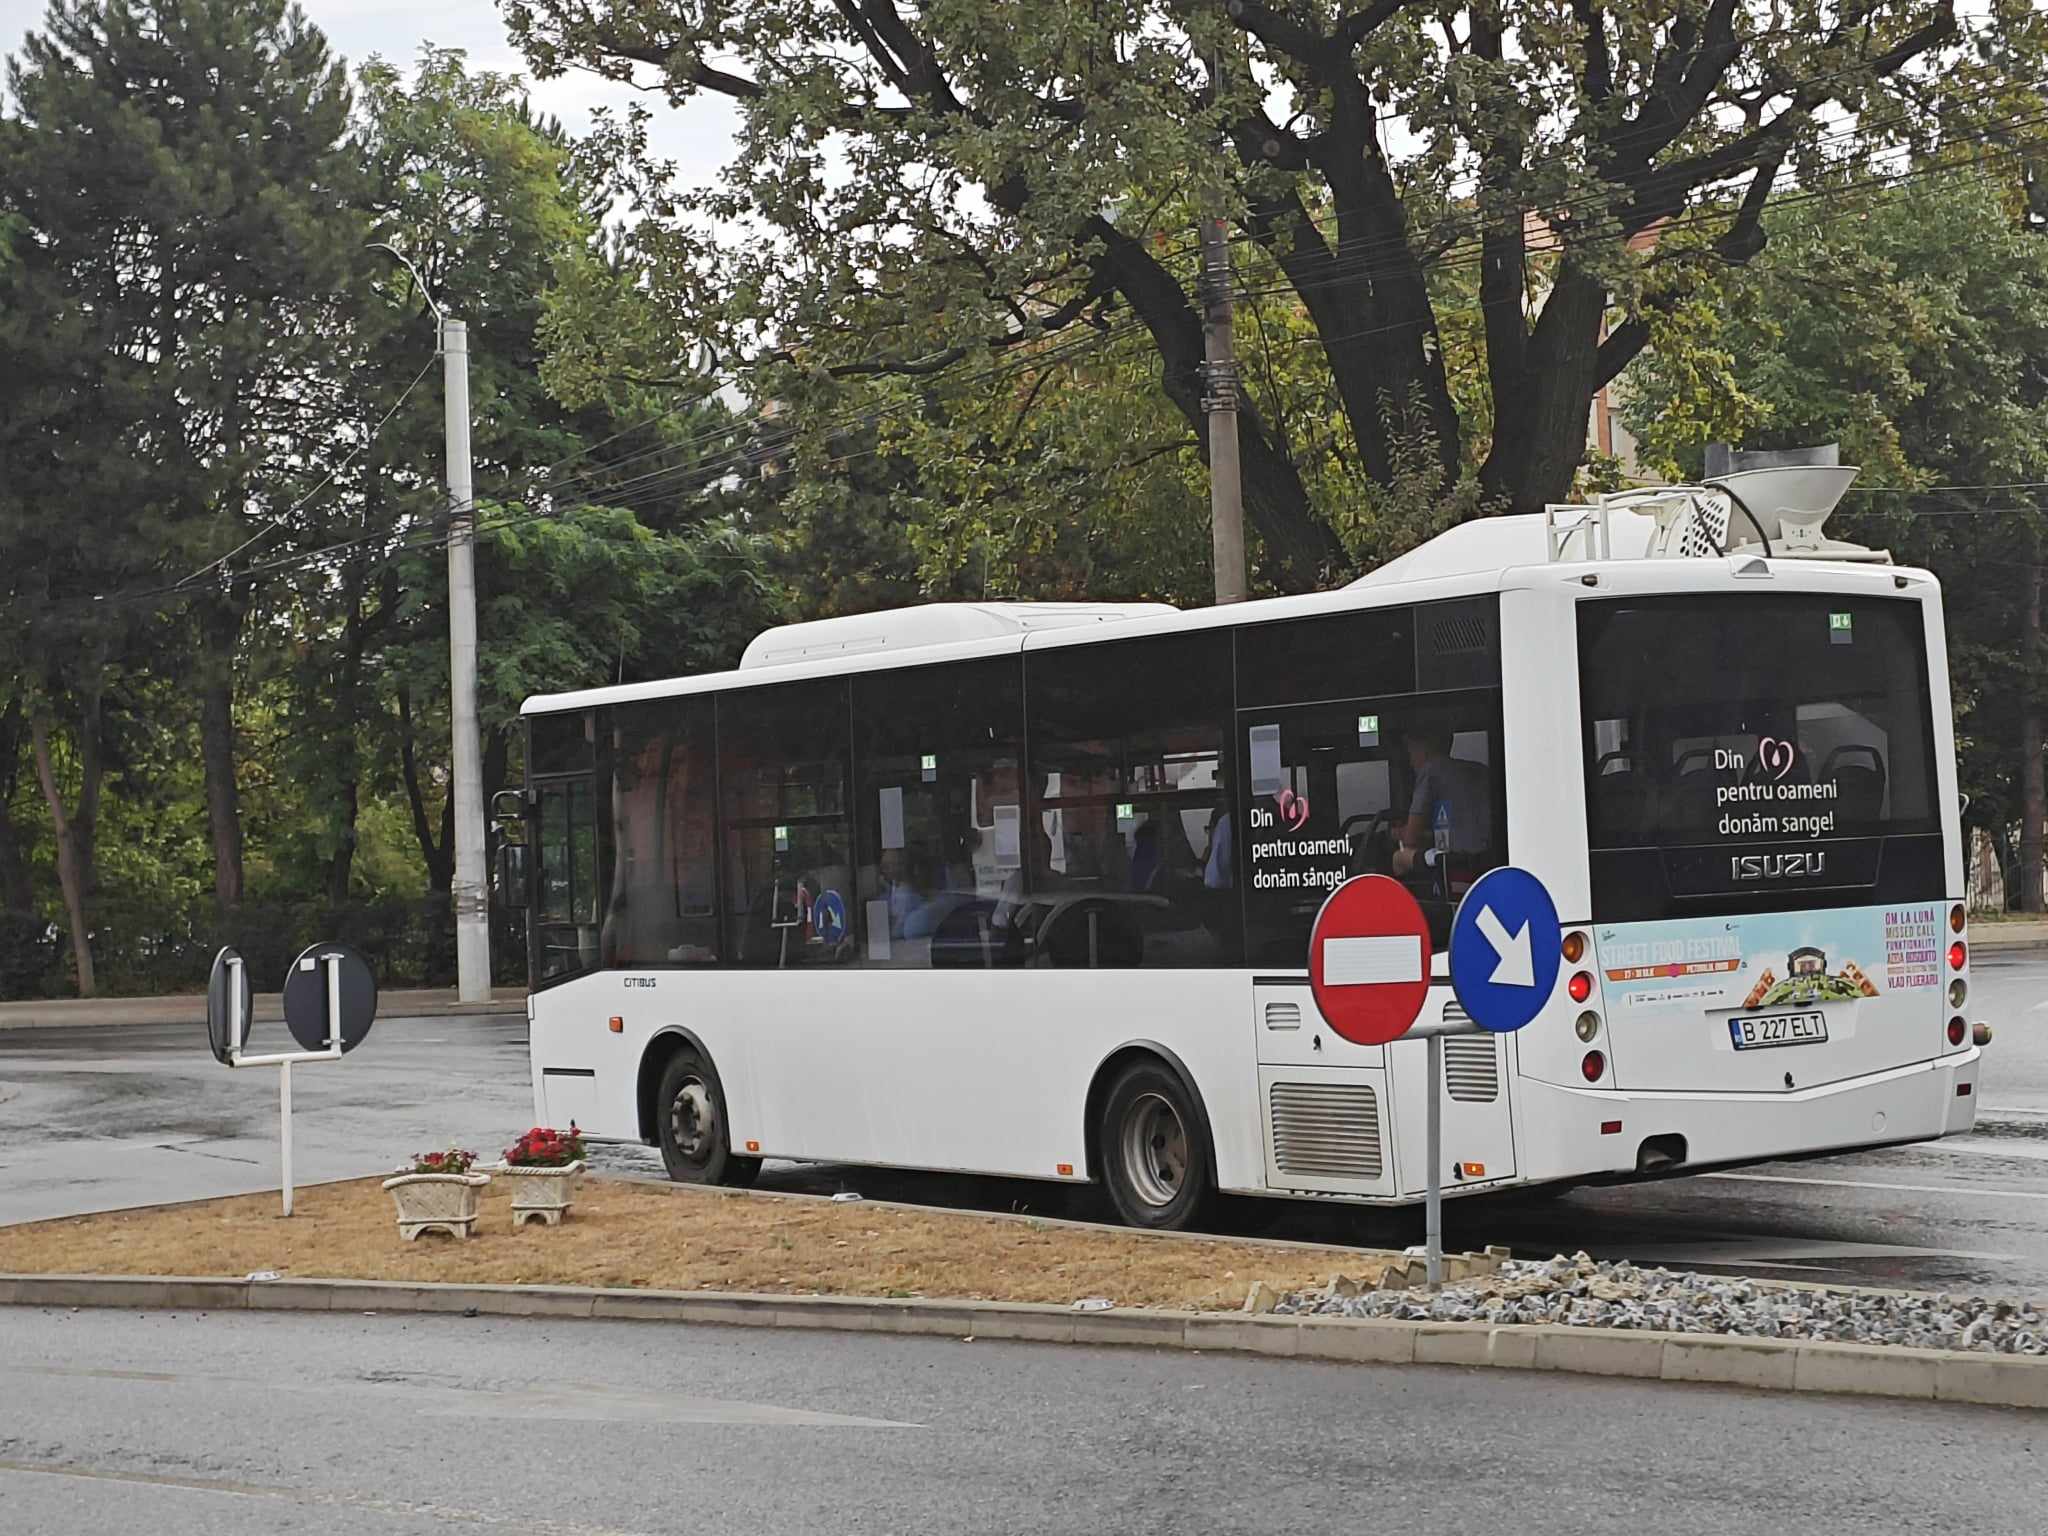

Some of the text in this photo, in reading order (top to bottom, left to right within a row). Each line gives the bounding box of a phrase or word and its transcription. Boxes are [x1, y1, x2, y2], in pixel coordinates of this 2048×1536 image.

[1715, 748, 1744, 769] Din
[1716, 778, 1837, 807] pentru oameni
[1251, 808, 1273, 828] Din
[1718, 810, 1834, 838] donăm sange!
[1252, 833, 1353, 863] pentru oameni,
[1253, 867, 1300, 888] donăm
[1731, 851, 1825, 880] ISUZU
[1651, 938, 1685, 963] FOOD
[1687, 935, 1742, 959] FESTIVAL
[1743, 1015, 1819, 1041] B 227 ELT
